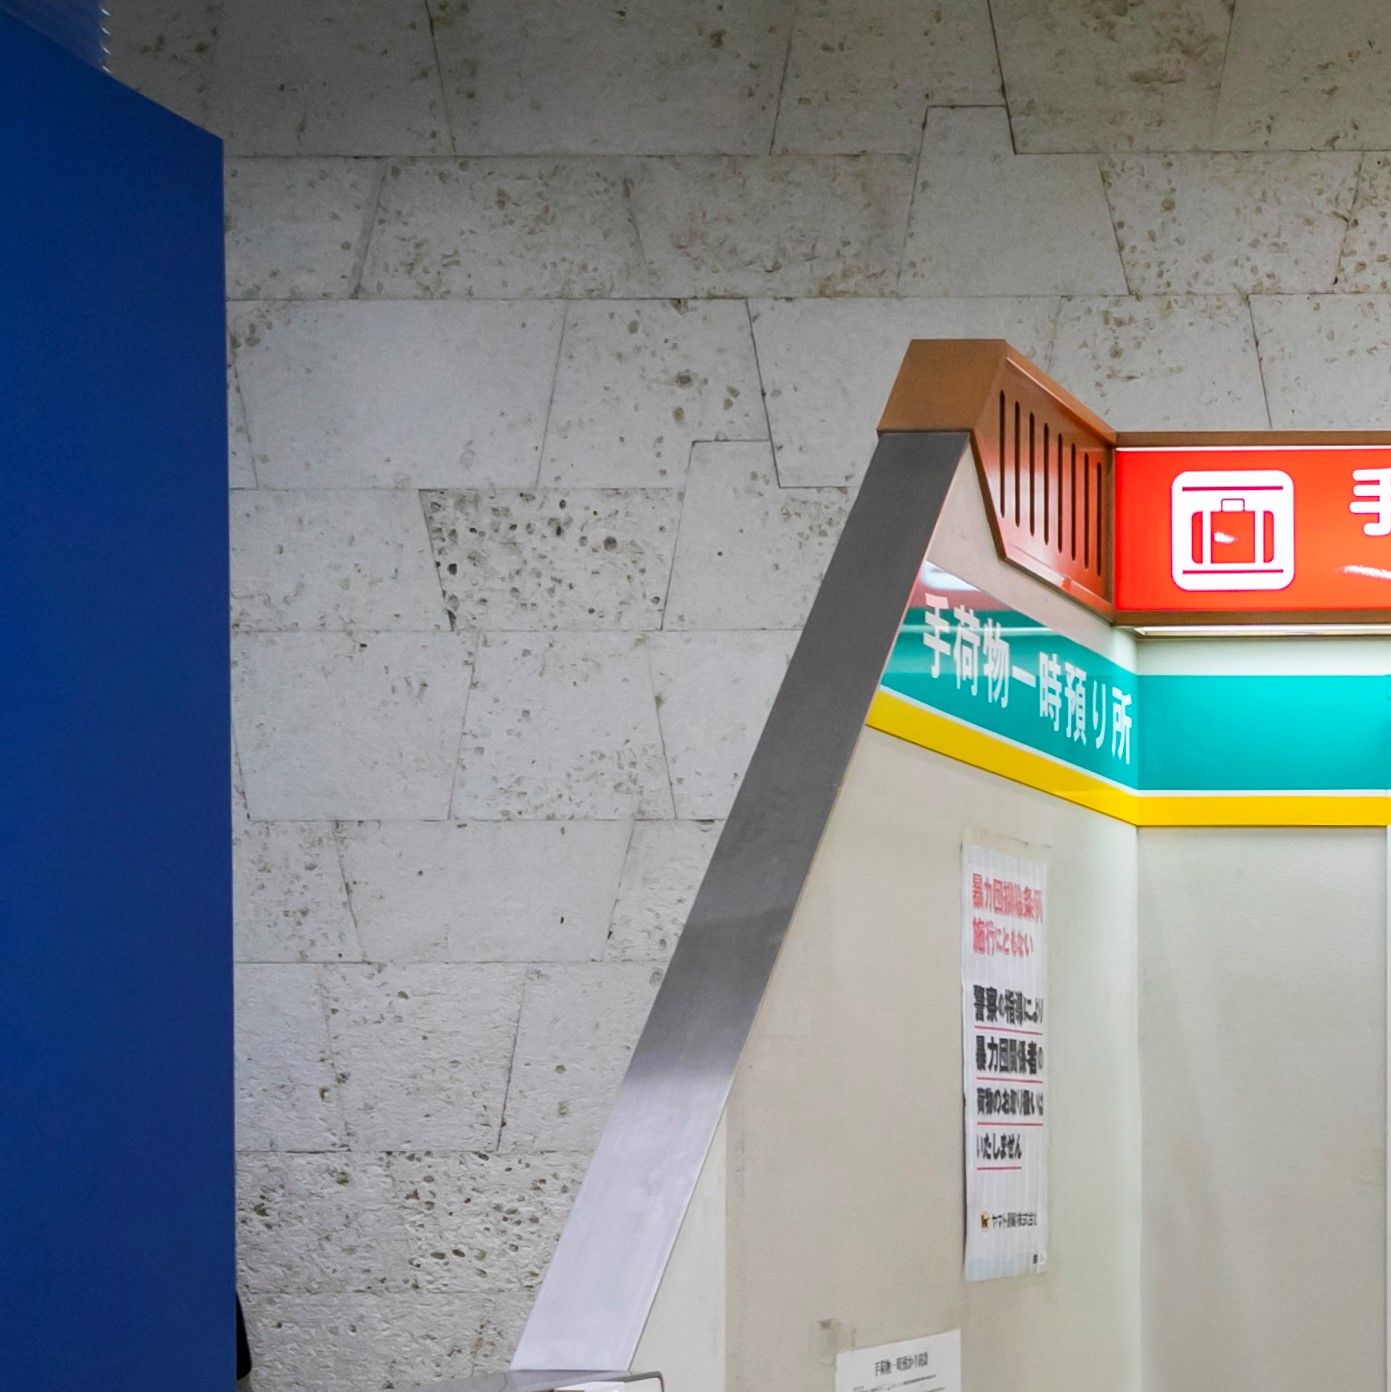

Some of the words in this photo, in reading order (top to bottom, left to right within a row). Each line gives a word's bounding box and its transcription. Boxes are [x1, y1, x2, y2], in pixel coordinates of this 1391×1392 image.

[923, 592, 1133, 765] 手荷物一時預り所
[975, 1035, 1044, 1075] 暴力団関係者の
[976, 1133, 1022, 1160] いたしません
